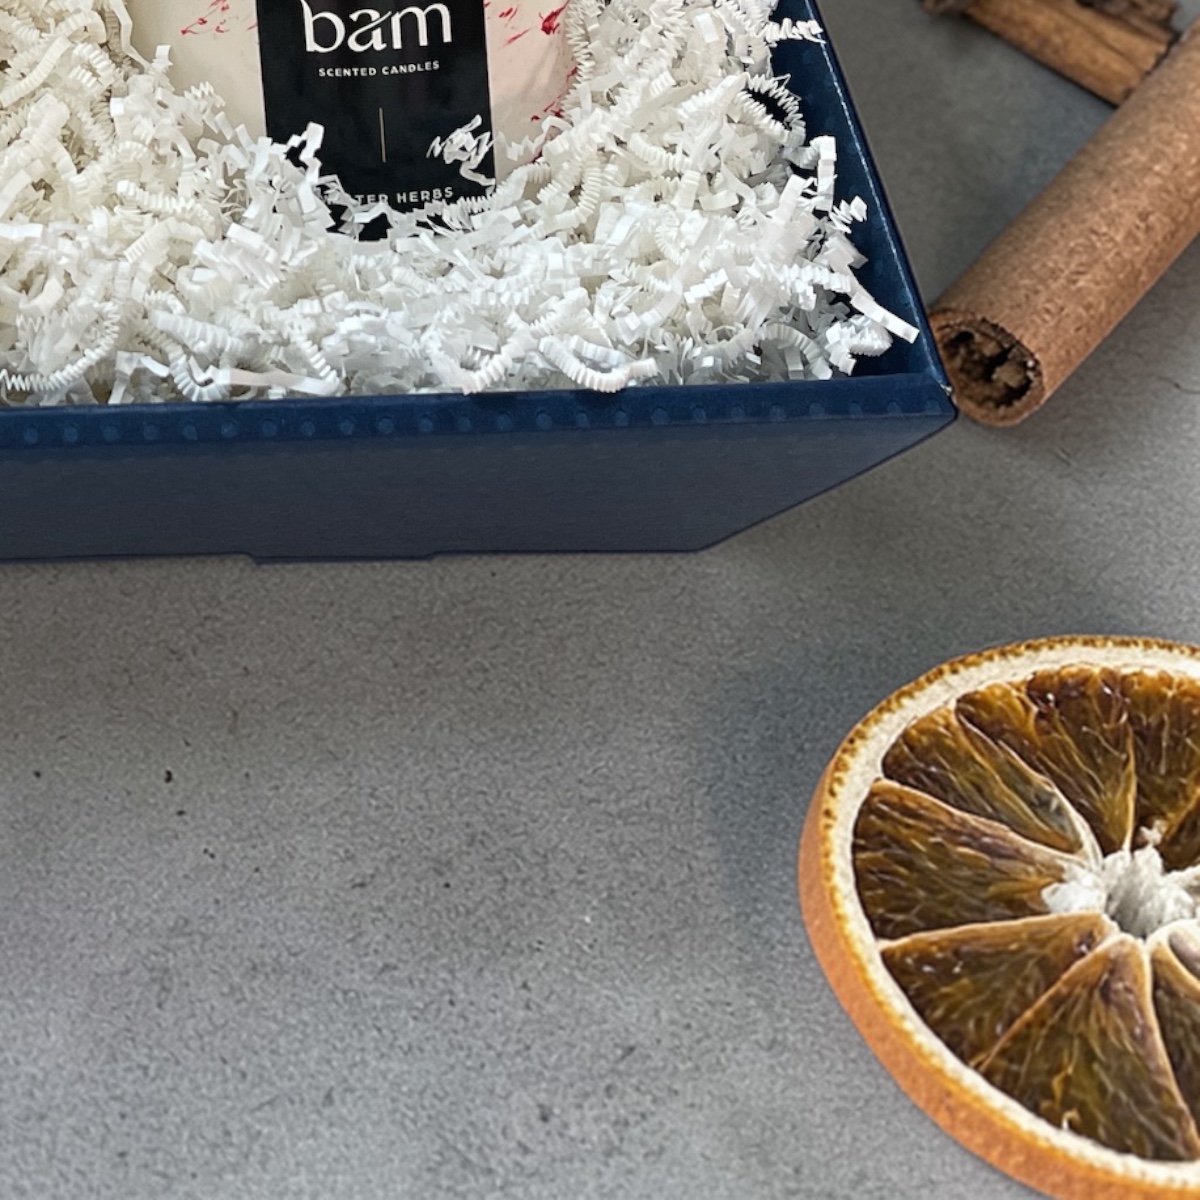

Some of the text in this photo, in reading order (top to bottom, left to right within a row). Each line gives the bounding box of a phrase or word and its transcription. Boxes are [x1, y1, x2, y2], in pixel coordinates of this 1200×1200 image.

[318, 60, 440, 78] SCENTED CANDLES
[397, 186, 454, 204] HERBS
